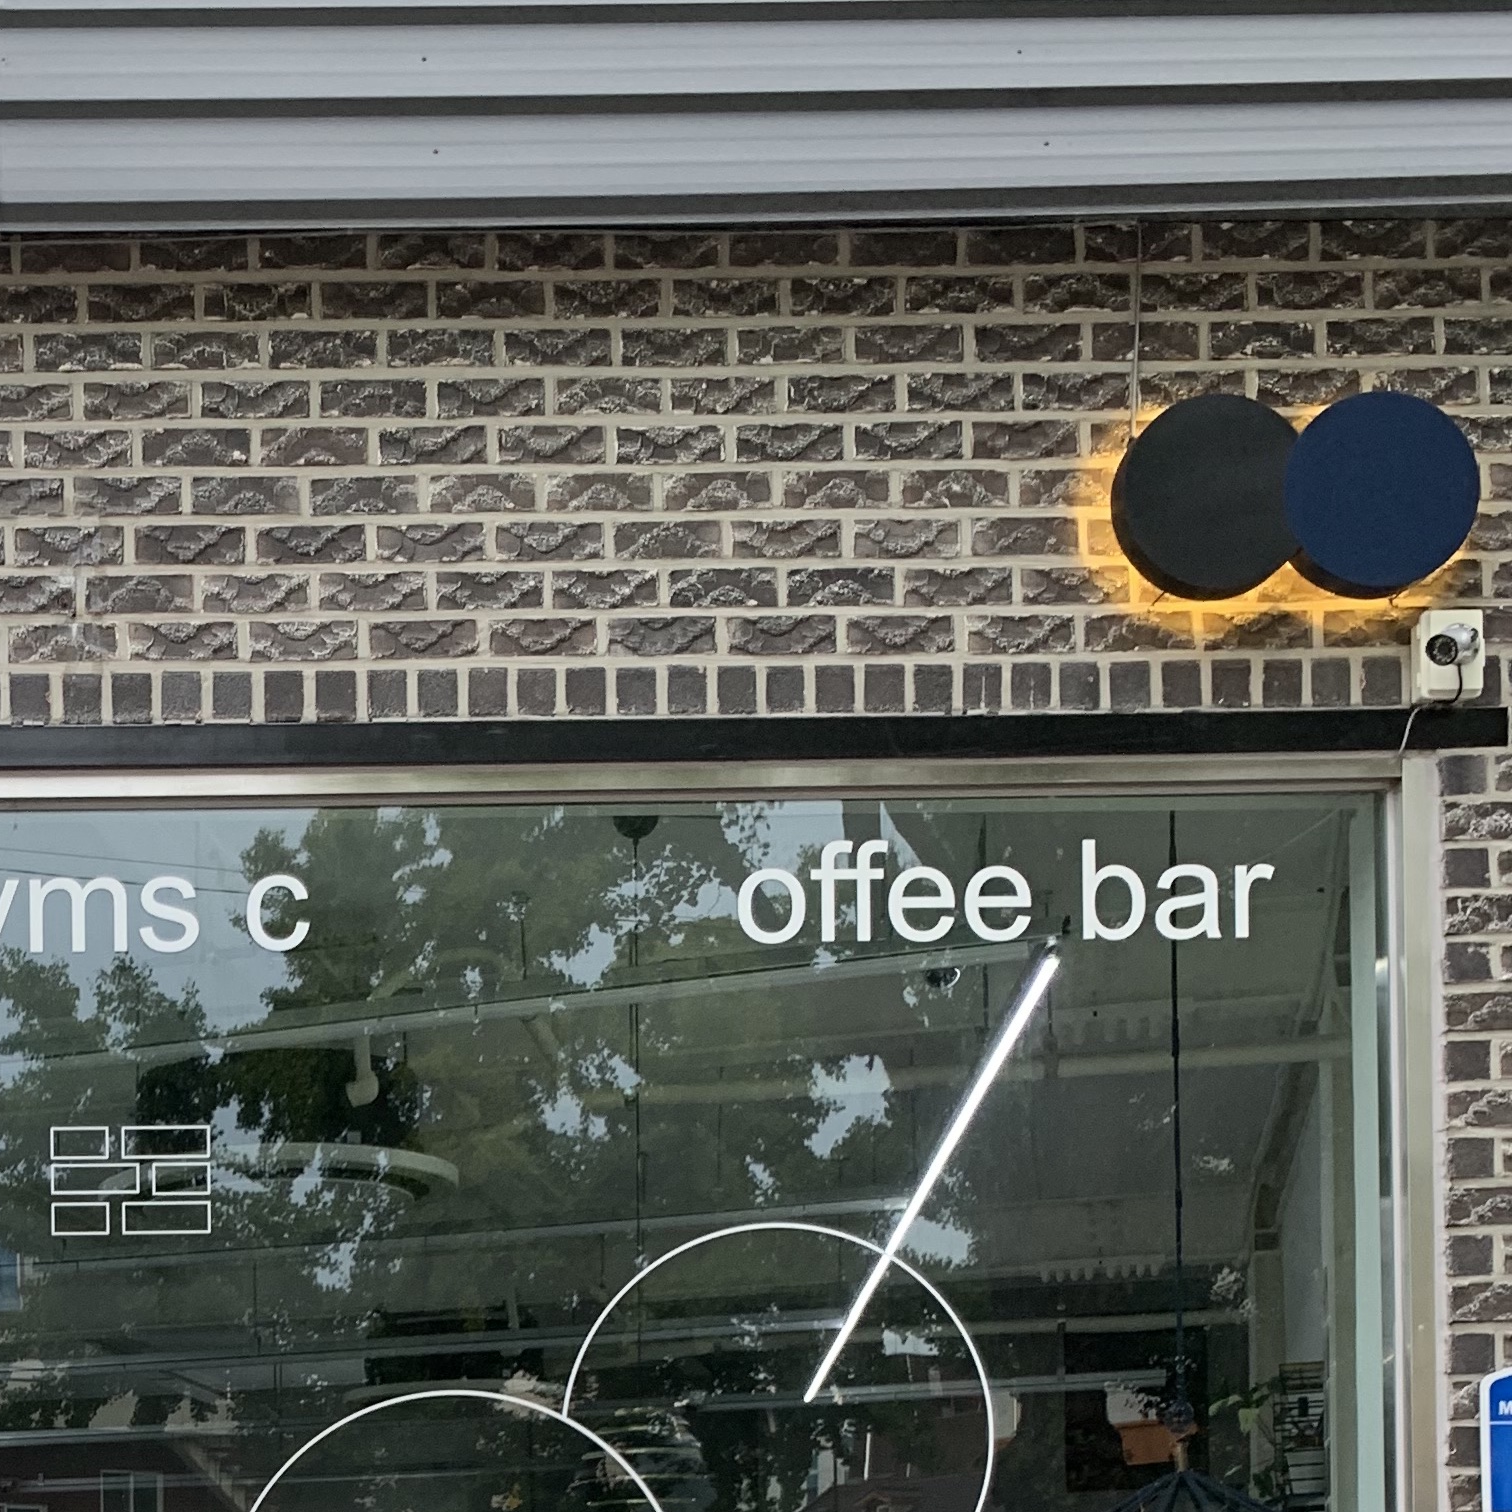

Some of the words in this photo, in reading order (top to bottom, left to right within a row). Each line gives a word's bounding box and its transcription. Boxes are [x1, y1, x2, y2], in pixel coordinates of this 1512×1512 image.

[245, 874, 311, 953] c
[735, 838, 1034, 945] offee
[1080, 838, 1276, 944] bar
